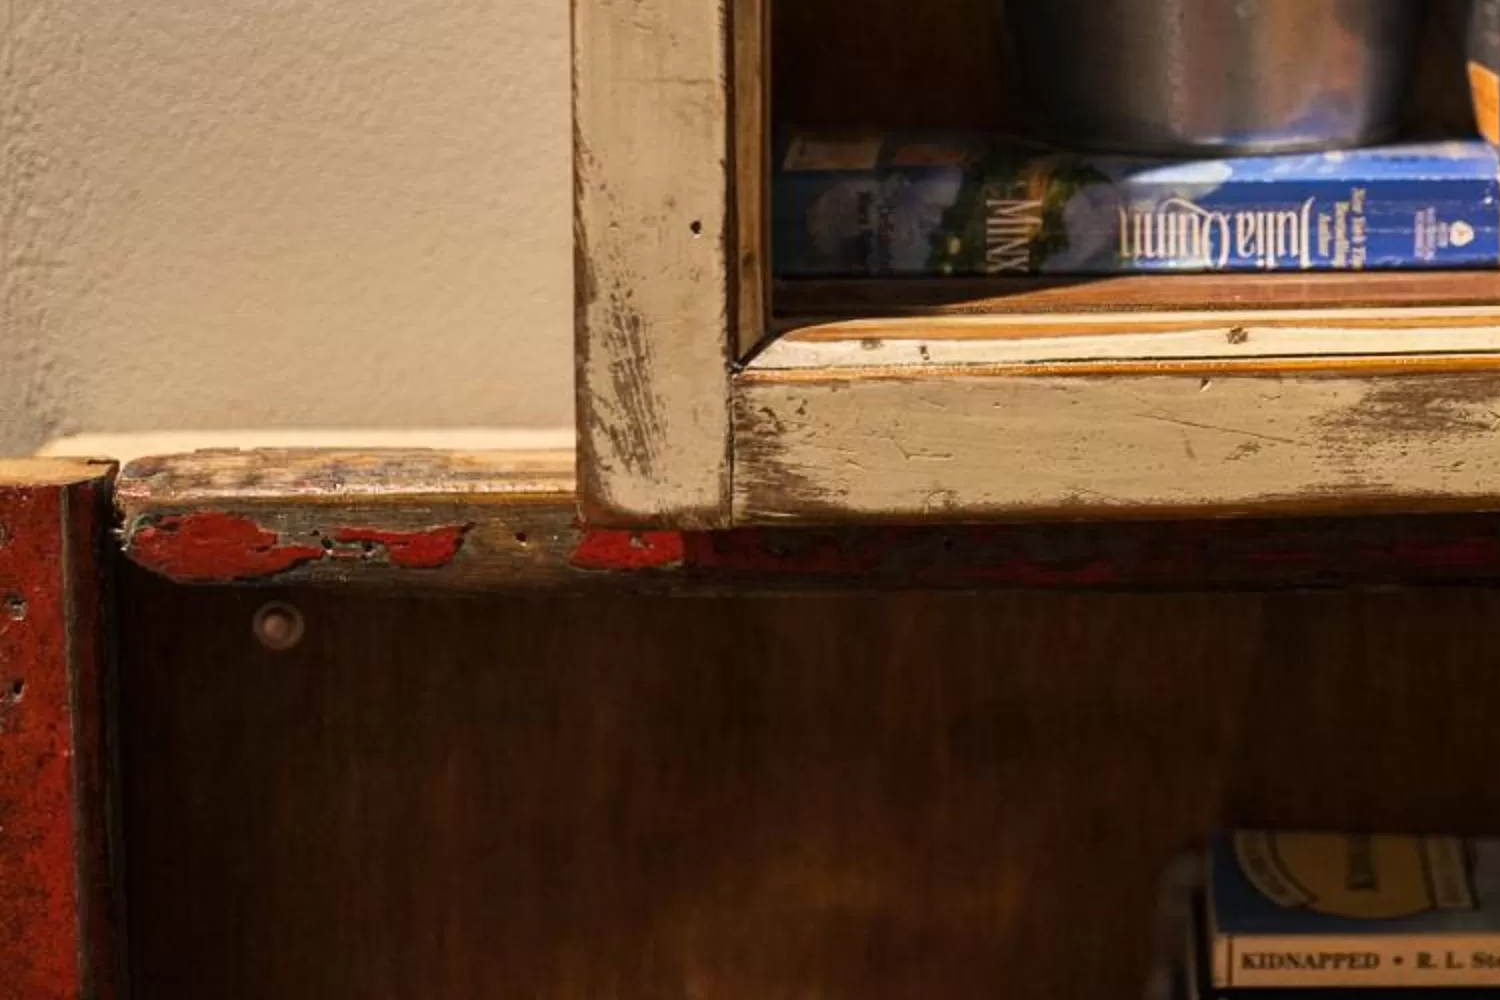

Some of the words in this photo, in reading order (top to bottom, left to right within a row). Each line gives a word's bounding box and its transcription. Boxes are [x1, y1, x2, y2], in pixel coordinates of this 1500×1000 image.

[986, 199, 1043, 275] MINX
[1119, 196, 1232, 269] Quinn
[1233, 195, 1315, 270] Julia
[1240, 951, 1381, 971] KIDNAPPED
[1416, 951, 1439, 971] R.
[1445, 951, 1466, 971] L.
